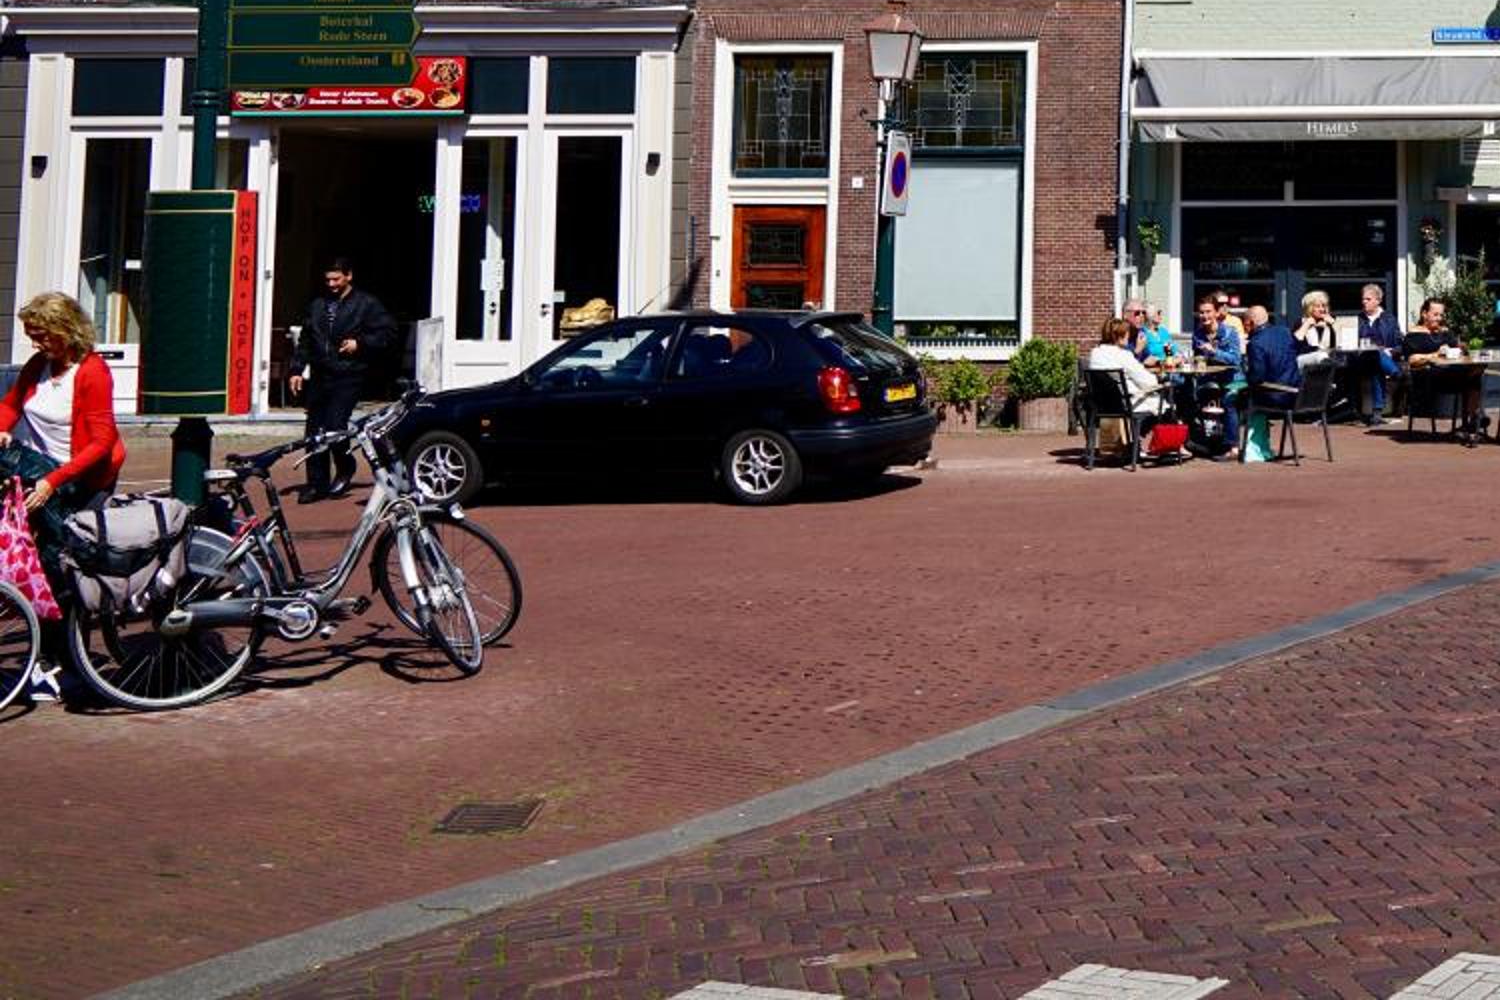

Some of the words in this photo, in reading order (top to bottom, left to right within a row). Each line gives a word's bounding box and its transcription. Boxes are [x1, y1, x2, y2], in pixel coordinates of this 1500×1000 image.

[239, 208, 251, 245] HOP
[239, 255, 250, 281] ON
[237, 311, 249, 350] HOP
